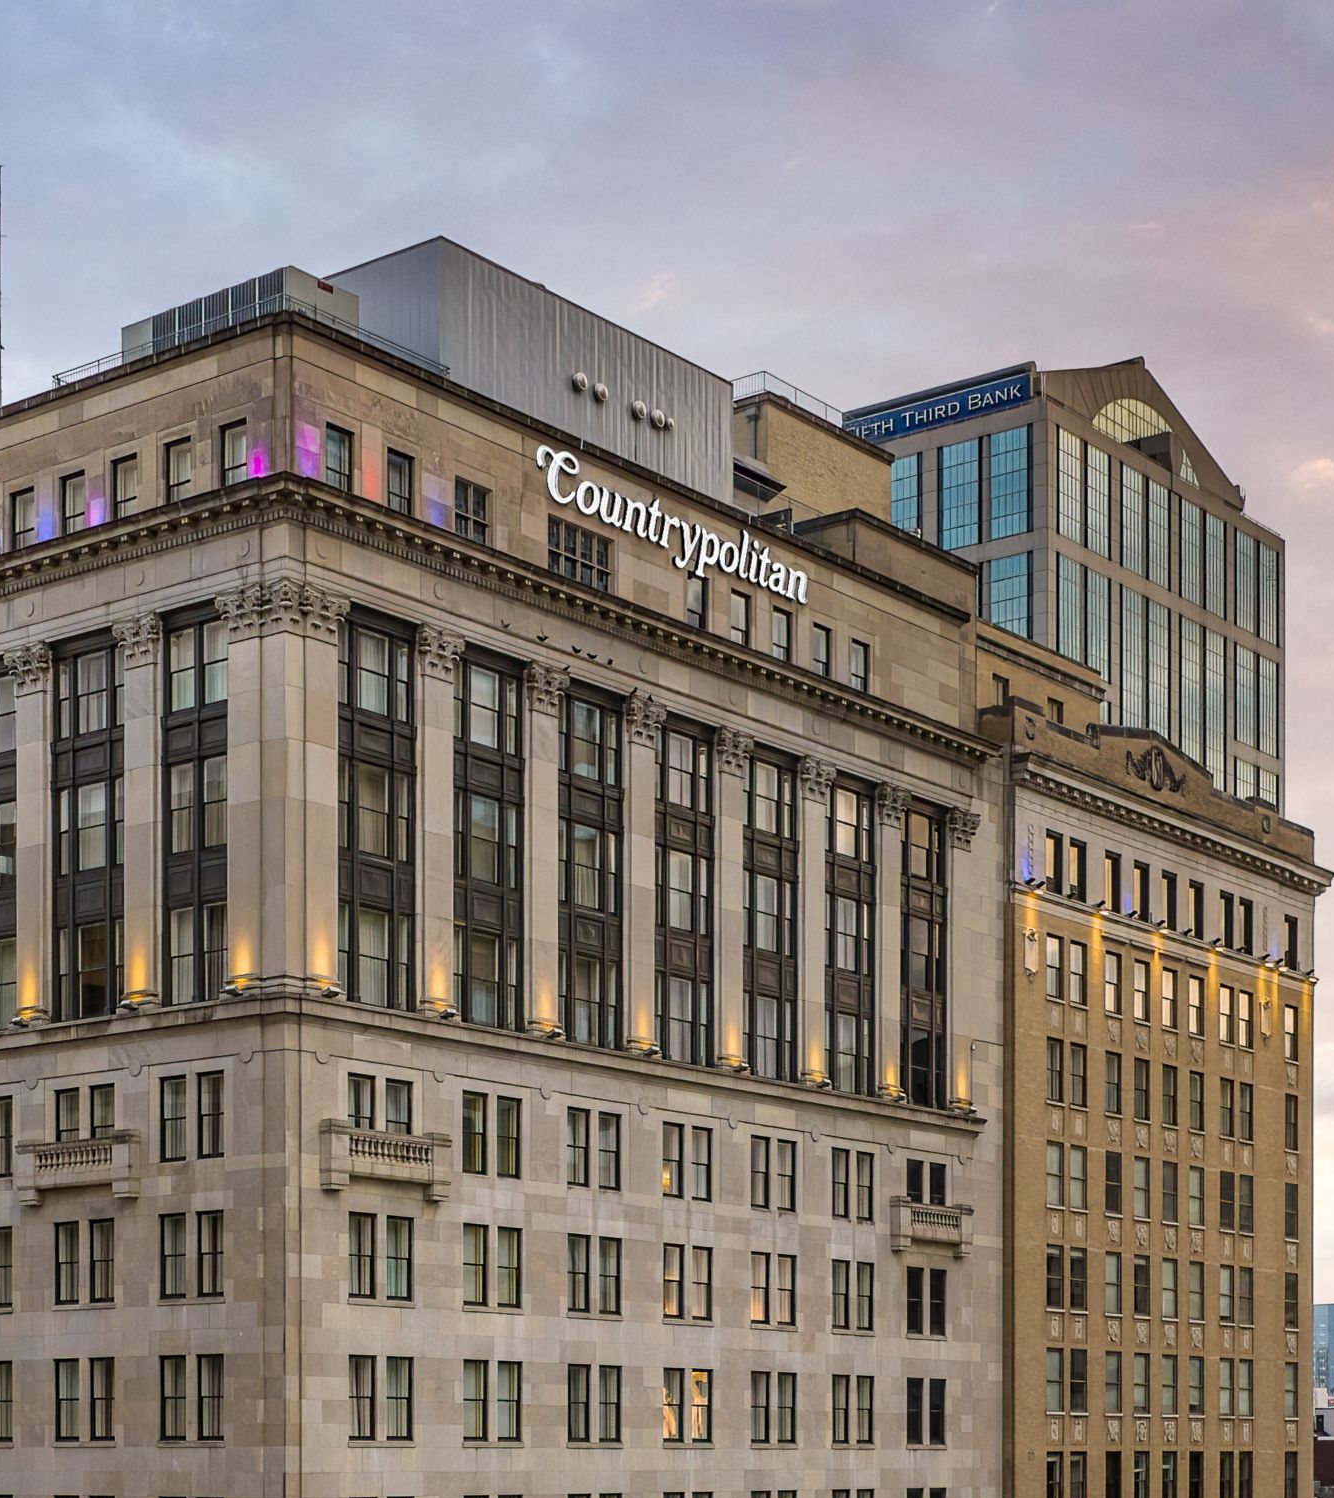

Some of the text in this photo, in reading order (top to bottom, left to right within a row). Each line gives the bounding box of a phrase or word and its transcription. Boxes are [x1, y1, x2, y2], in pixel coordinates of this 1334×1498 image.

[901, 402, 960, 427] THIRD
[968, 384, 1022, 410] BANK
[536, 444, 809, 604] Countrypolitan
